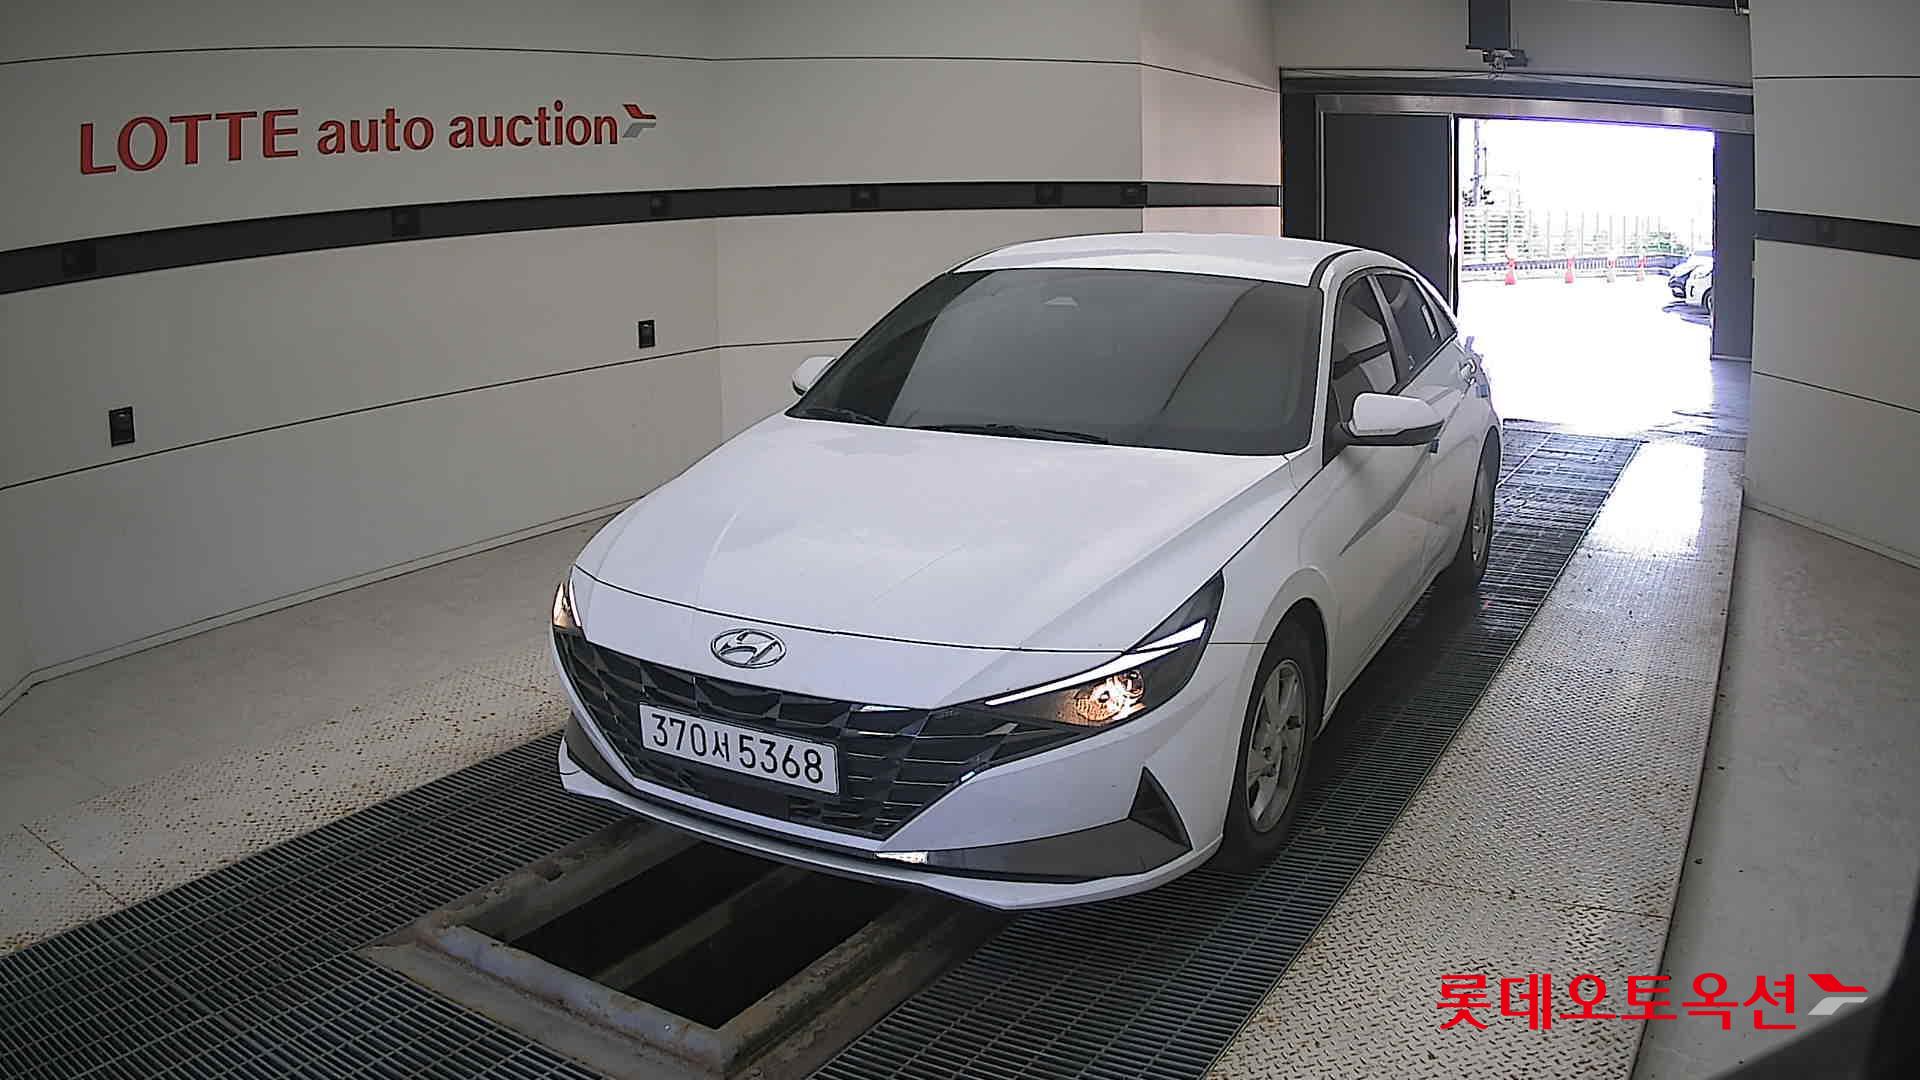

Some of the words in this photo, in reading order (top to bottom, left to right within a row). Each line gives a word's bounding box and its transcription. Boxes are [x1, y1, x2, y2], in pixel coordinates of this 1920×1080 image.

[80, 108, 299, 175] LOTTE
[316, 107, 435, 155] auto
[448, 100, 619, 150] auction
